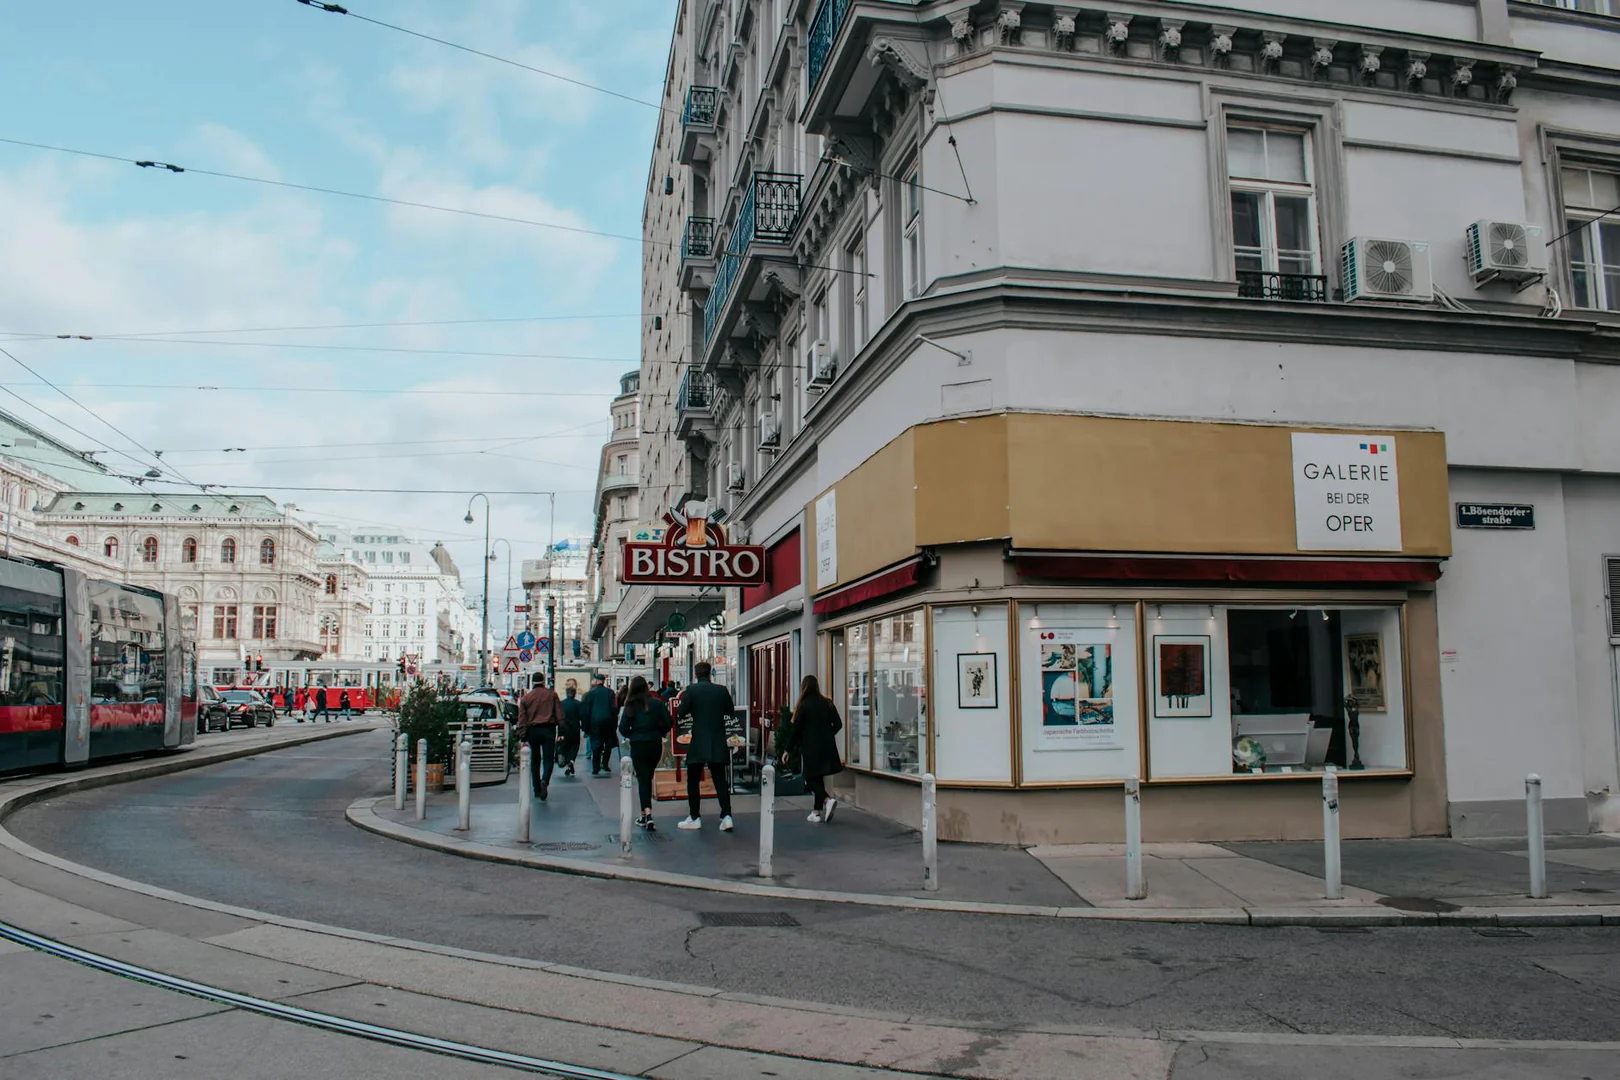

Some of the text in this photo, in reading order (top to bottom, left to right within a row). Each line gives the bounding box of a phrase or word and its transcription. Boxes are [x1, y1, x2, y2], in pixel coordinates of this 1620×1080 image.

[1303, 462, 1389, 482] GALERIE
[1326, 492, 1370, 505] BEI DER
[1326, 514, 1374, 532] OPER
[631, 548, 760, 578] BISTRO
